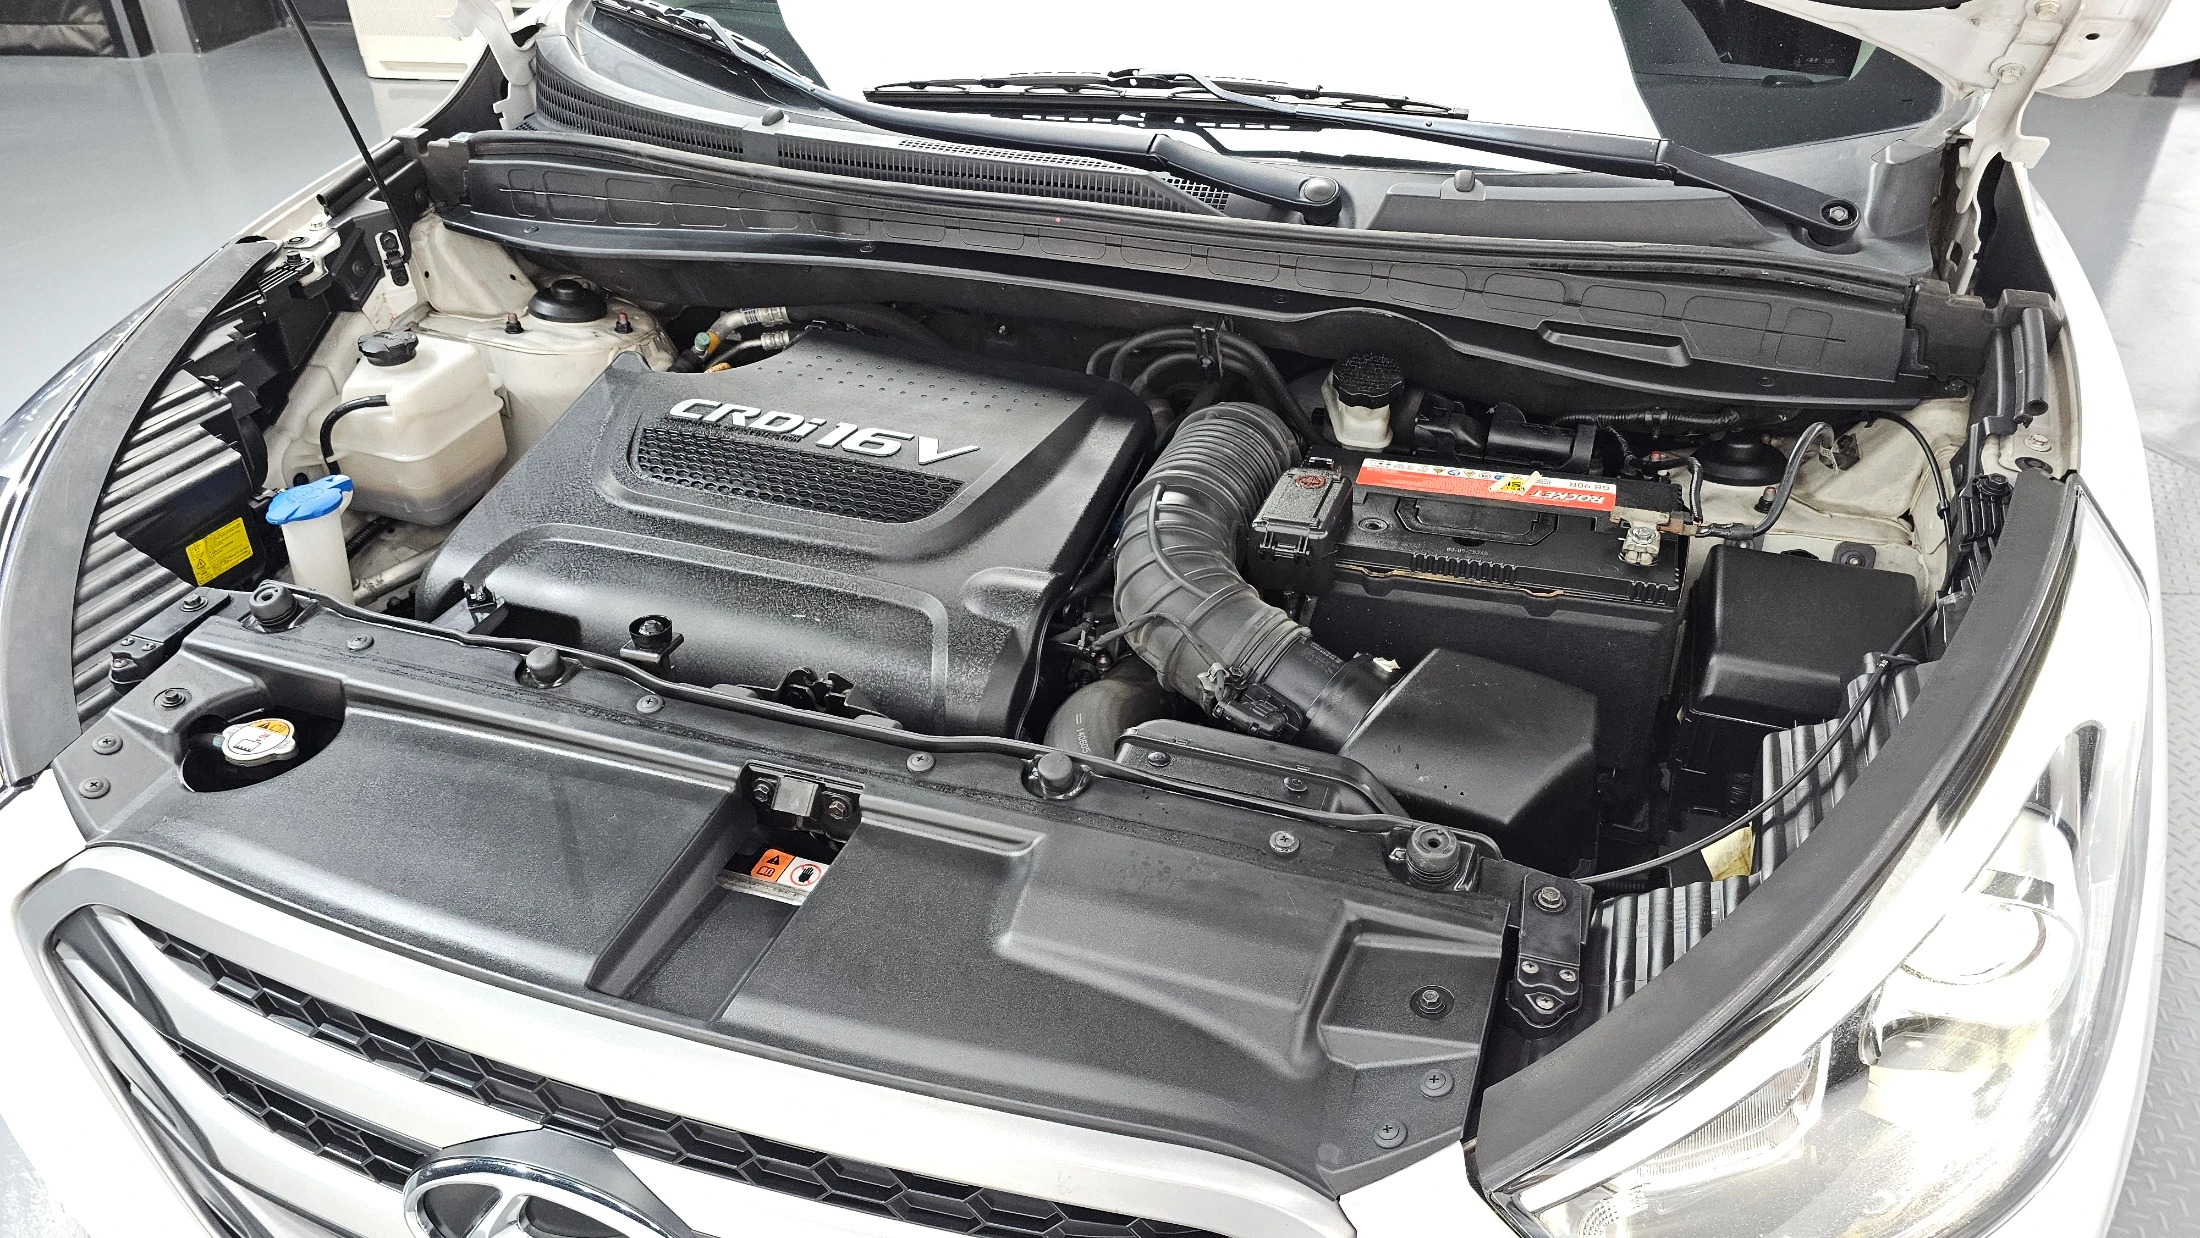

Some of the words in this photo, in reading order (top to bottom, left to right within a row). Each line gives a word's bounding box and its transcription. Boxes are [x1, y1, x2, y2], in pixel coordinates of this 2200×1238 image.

[668, 398, 828, 438] CRDi
[815, 421, 982, 466] 16V
[1568, 481, 1592, 490] 90R
[1594, 483, 1610, 491] GB
[1528, 488, 1606, 505] ROCKET
